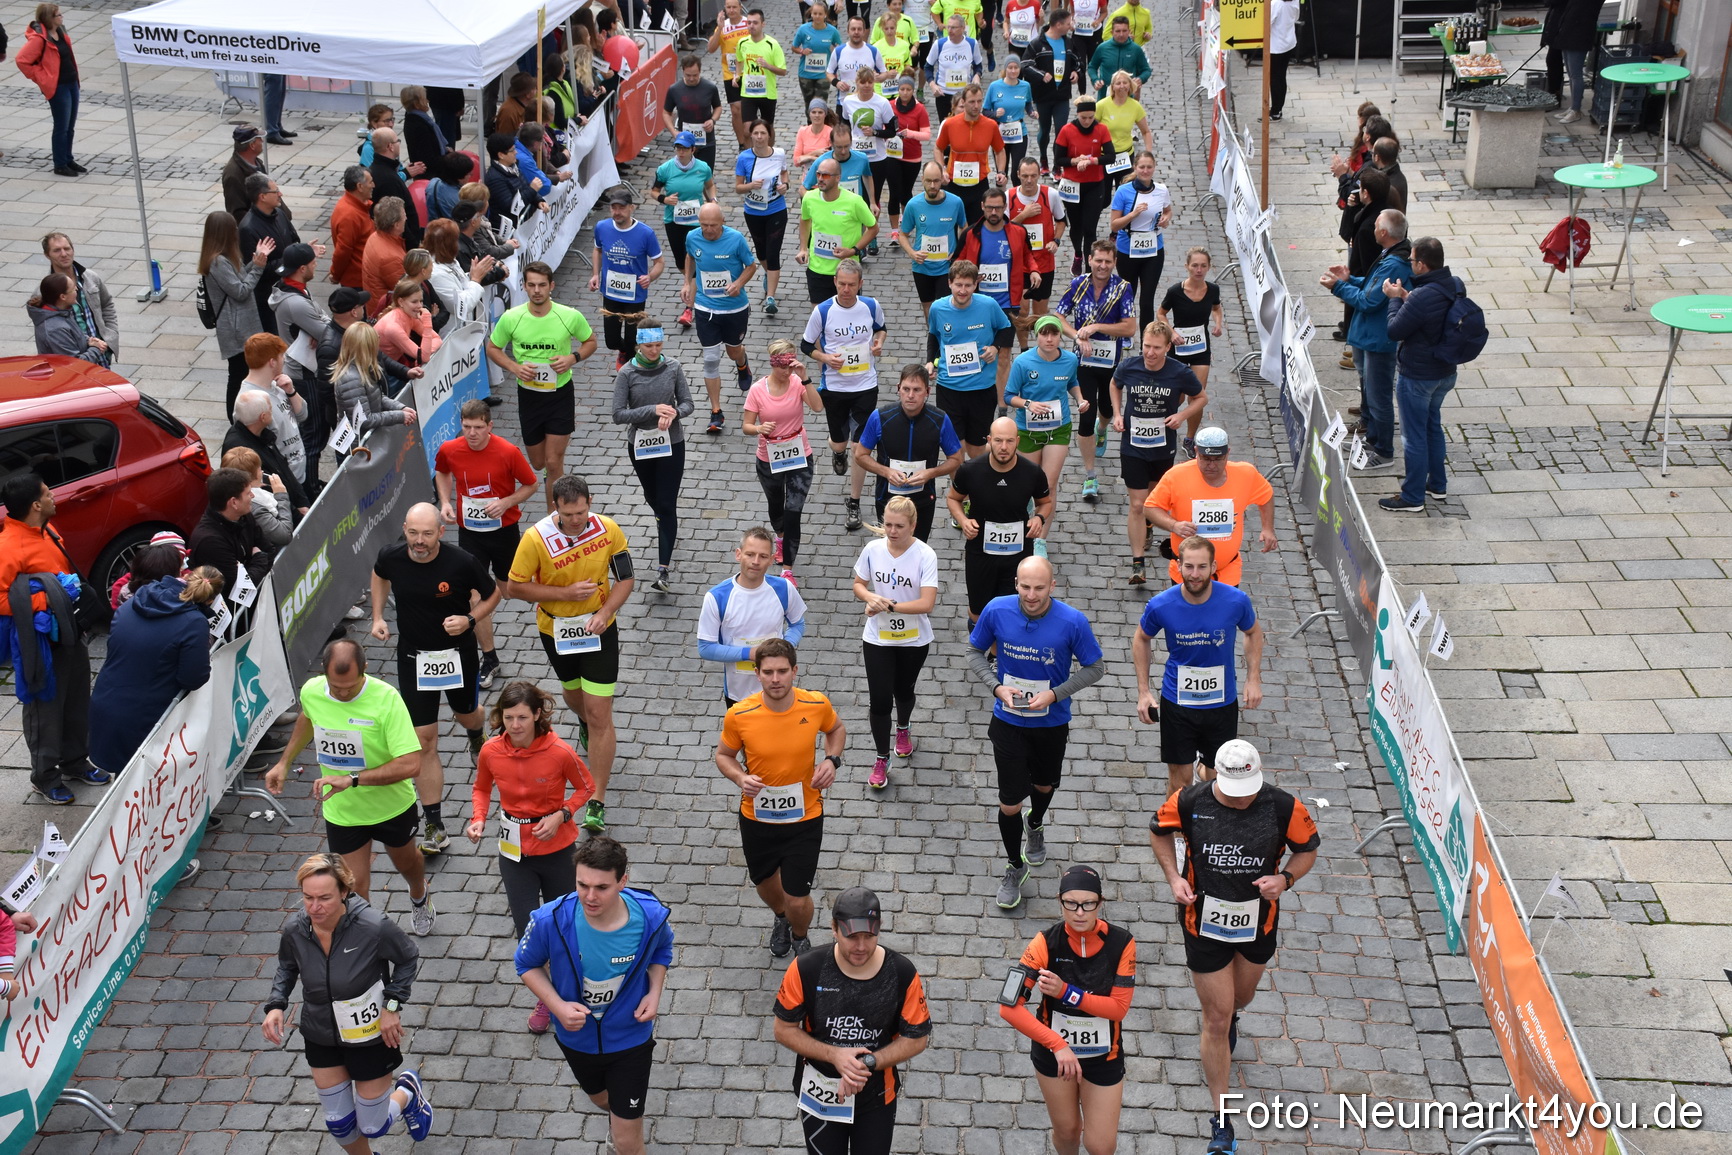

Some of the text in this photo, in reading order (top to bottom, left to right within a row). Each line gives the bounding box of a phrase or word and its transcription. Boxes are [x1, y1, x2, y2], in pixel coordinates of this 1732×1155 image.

[1235, 8, 1257, 19] lauf
[131, 25, 321, 53] BMW ConnectedDrive
[134, 44, 279, 64] Vernetzt, um frei zu sein.
[944, 53, 968, 63] SUSPA
[1055, 66, 1063, 74] 66
[884, 79, 899, 88] 2045
[1002, 128, 1019, 136] 2237
[856, 142, 873, 150] 2554
[960, 170, 973, 178] 152
[746, 191, 764, 202] 2422
[678, 208, 696, 216] 2361
[818, 240, 838, 250] 2713
[926, 244, 941, 252] 301
[1134, 240, 1153, 248] 2431
[706, 279, 728, 288] 2222
[982, 273, 1002, 282] 2421
[610, 280, 632, 290] 2604
[834, 323, 868, 339] SUSPA
[1300, 325, 1312, 341] swn
[1185, 335, 1202, 345] 798
[847, 354, 860, 364] 54
[950, 352, 974, 365] 2539
[1091, 348, 1111, 358] 137
[1130, 386, 1171, 397] AUCKLAND
[1135, 426, 1160, 436] 2205
[335, 428, 350, 448] swn
[638, 436, 665, 447] 2020
[773, 447, 800, 460] 2179
[467, 508, 488, 519] 223
[1198, 510, 1228, 523] 2586
[990, 532, 1018, 544] 2157
[554, 537, 612, 571] MAX BÖGL
[875, 568, 914, 590] SUSPA
[282, 544, 330, 635] BOCK
[209, 608, 225, 632] swn
[889, 618, 906, 631] 39
[1003, 642, 1039, 654] Kirwaläufer
[1438, 630, 1450, 654] swn
[1004, 649, 1040, 662] Pettenhofen
[422, 660, 456, 676] 2920
[1184, 678, 1218, 690] 2105
[260, 706, 274, 728] GmbH
[320, 740, 358, 756] 2193
[760, 796, 797, 810] 2120
[1202, 843, 1244, 856] HECK
[1208, 855, 1266, 868] DESIGN
[12, 874, 36, 901] swn
[54, 864, 108, 946] UNS
[1210, 911, 1251, 928] 2180
[1220, 928, 1238, 936] Stefan
[72, 967, 125, 1049] Service-Line:
[124, 954, 132, 967] 0
[582, 990, 614, 1004] 250
[350, 1001, 380, 1028] 153
[1515, 1004, 1524, 1020] für
[826, 1016, 865, 1028] HECK
[1525, 1000, 1547, 1049] Neumarkts
[362, 1024, 378, 1035] Ilona
[830, 1028, 884, 1040] DESIGN
[1060, 1028, 1099, 1044] 2181
